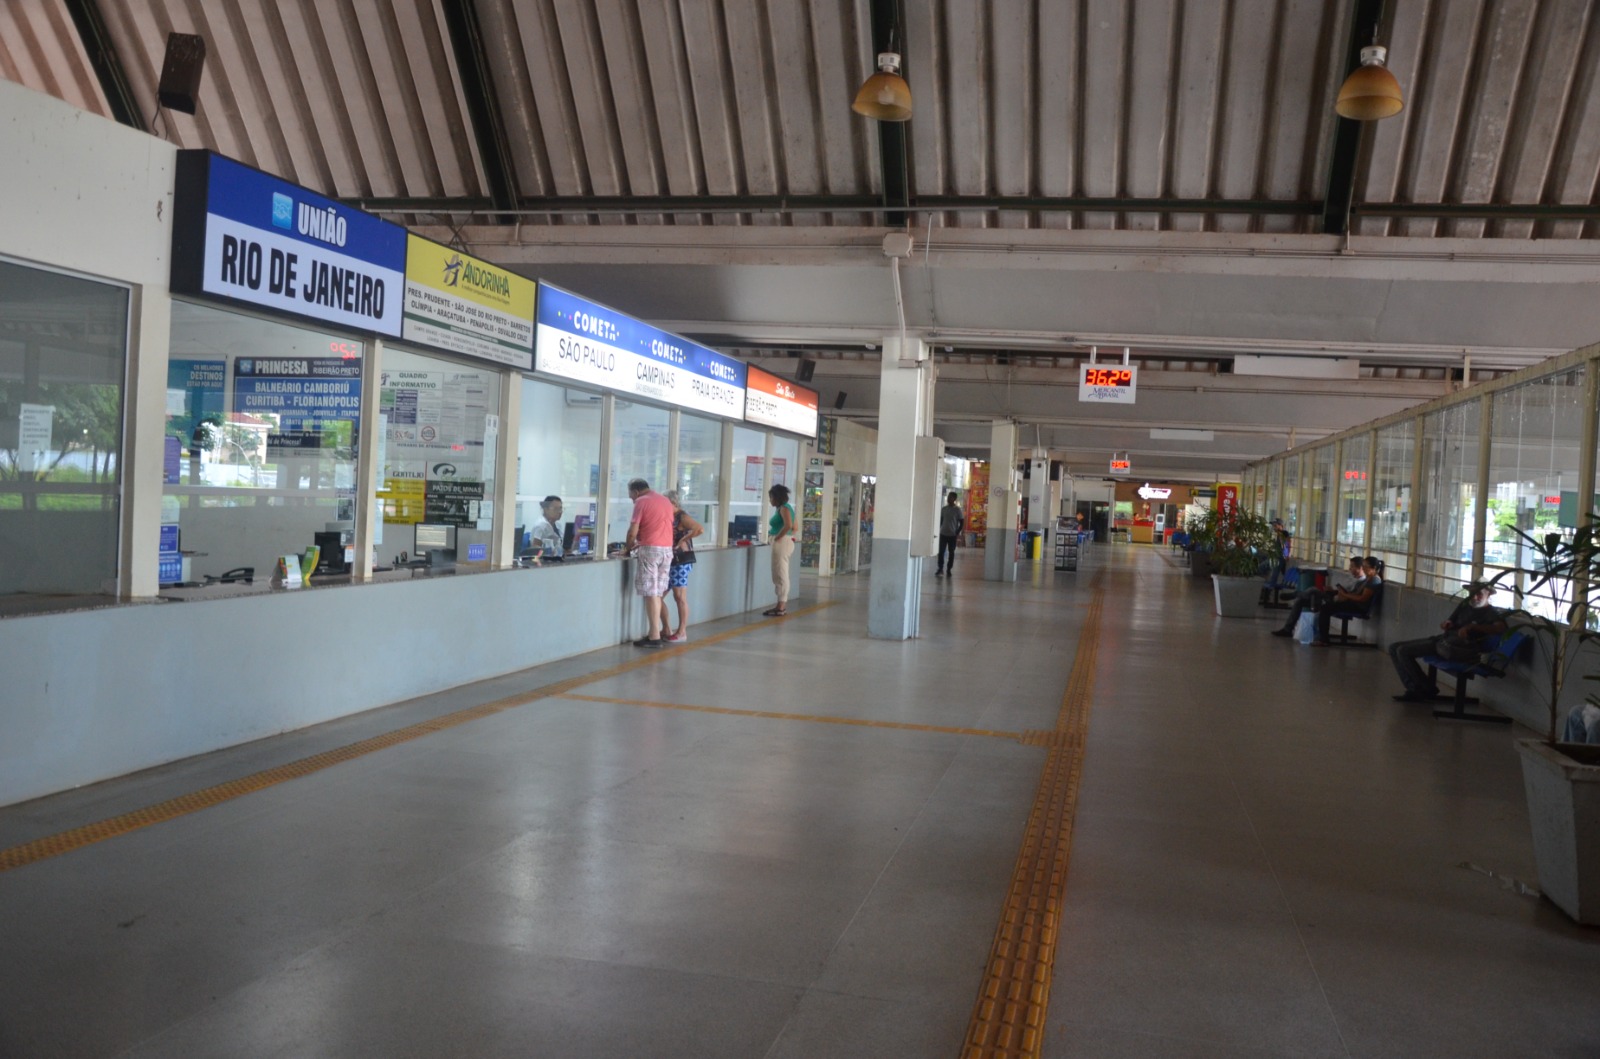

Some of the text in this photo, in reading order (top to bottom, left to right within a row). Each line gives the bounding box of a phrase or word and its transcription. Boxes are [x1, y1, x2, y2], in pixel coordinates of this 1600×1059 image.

[298, 202, 347, 247] UNIÃO
[221, 234, 385, 320] RIO DE JANEIRO
[462, 261, 510, 298] ANDORINHA
[408, 287, 422, 299] PRES.
[424, 292, 451, 308] PRUDENTE
[454, 302, 465, 312] SÃO
[465, 306, 477, 317] JOSÉ
[478, 310, 485, 318] DO
[485, 312, 493, 321] RIO
[493, 315, 507, 326] PRETO
[510, 321, 531, 334] BARRETOS
[411, 300, 433, 313] OLÍMPIA
[437, 308, 466, 323] ARAÇATUBA
[470, 318, 494, 332] PENÁPOLIS
[497, 327, 517, 339] OSVALDO
[517, 333, 528, 343] CRUZ
[574, 311, 616, 342] COMETA
[559, 336, 581, 363] SÃO
[583, 345, 615, 372] PAULO
[651, 339, 683, 364] COMETA
[190, 371, 223, 381] DESTINOS
[255, 360, 308, 374] PRINCESA
[313, 366, 340, 375] RIBEIRÃO
[399, 372, 427, 380] QUADRO
[637, 362, 675, 389] CAMPINAS
[710, 360, 734, 382] COMETA
[255, 380, 349, 394] BALNEÁRIO CAMBORIÚ
[390, 381, 436, 389] INFORMATIVO
[692, 378, 710, 399] PRAIA
[1093, 387, 1126, 395] MERCANTIL
[246, 395, 359, 407] CURITIBA FLORIANÓPOLIS
[432, 484, 452, 493] PATOS
[453, 485, 462, 493] DE
